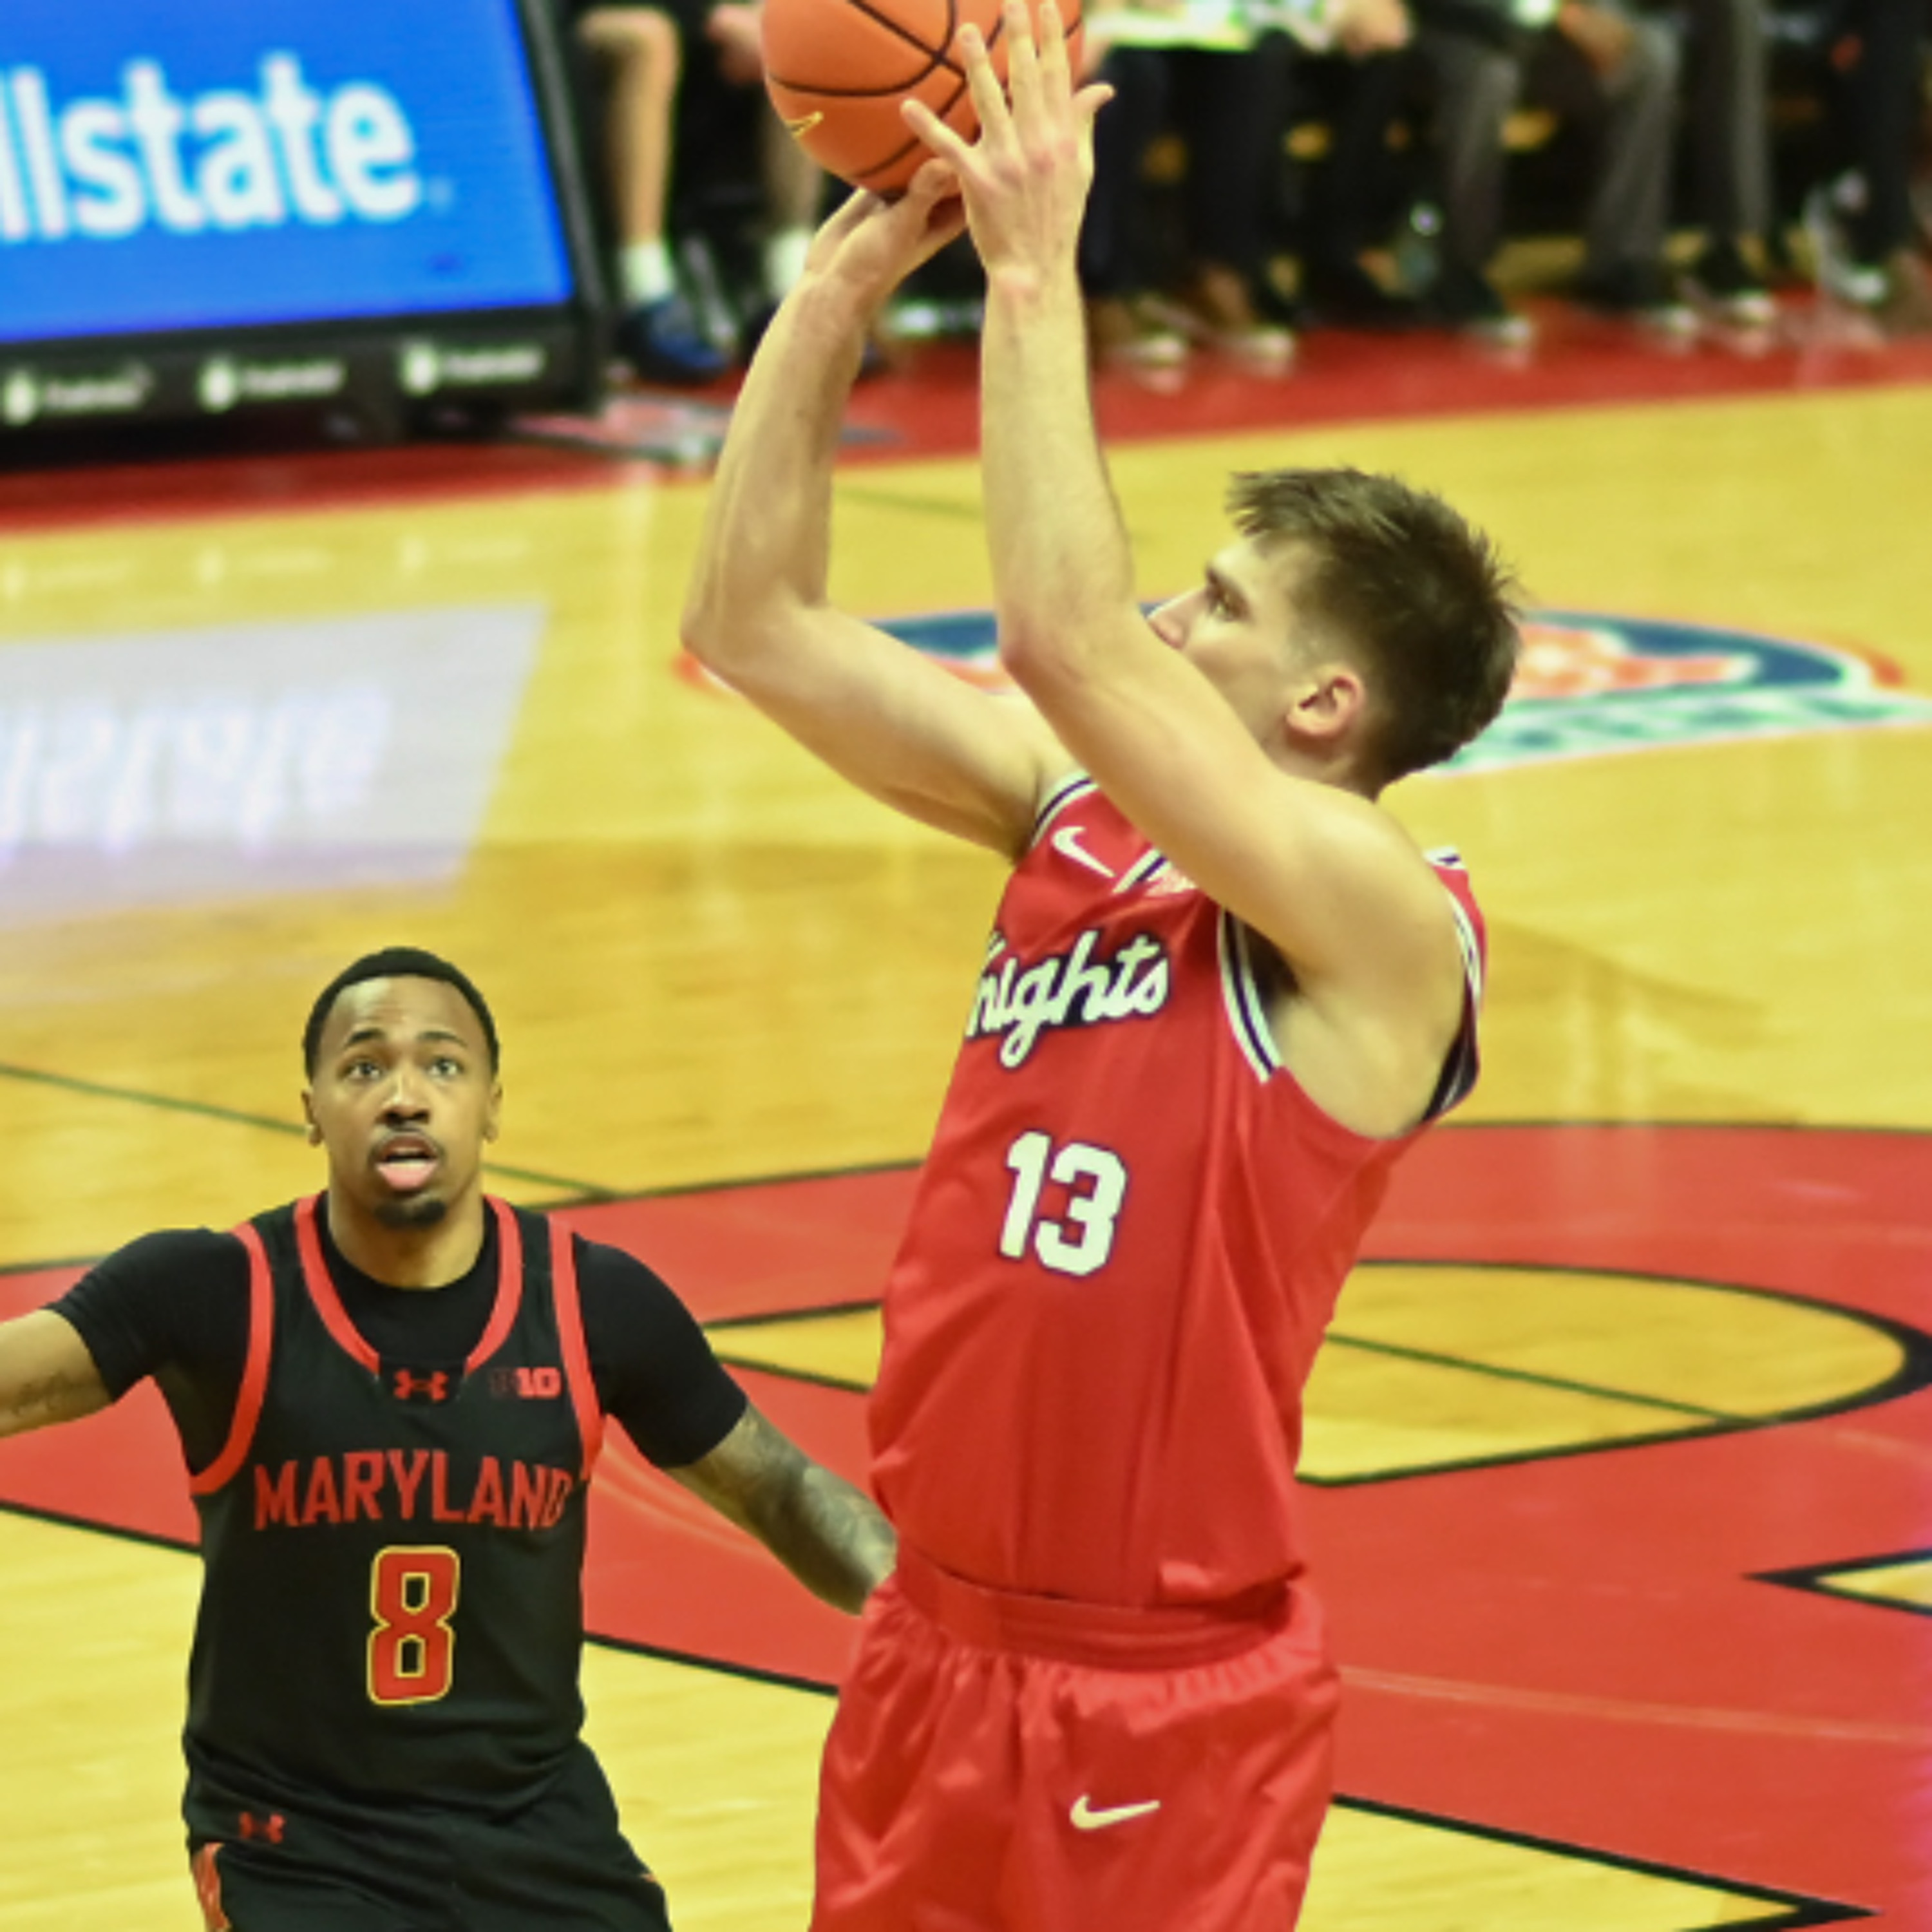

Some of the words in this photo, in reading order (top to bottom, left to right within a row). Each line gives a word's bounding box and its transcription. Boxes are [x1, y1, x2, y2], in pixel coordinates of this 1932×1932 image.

[965, 930, 1169, 1068] nights
[999, 1132, 1127, 1275] 13
[254, 1449, 573, 1531] MARYLAND
[368, 1546, 460, 1705] 8
